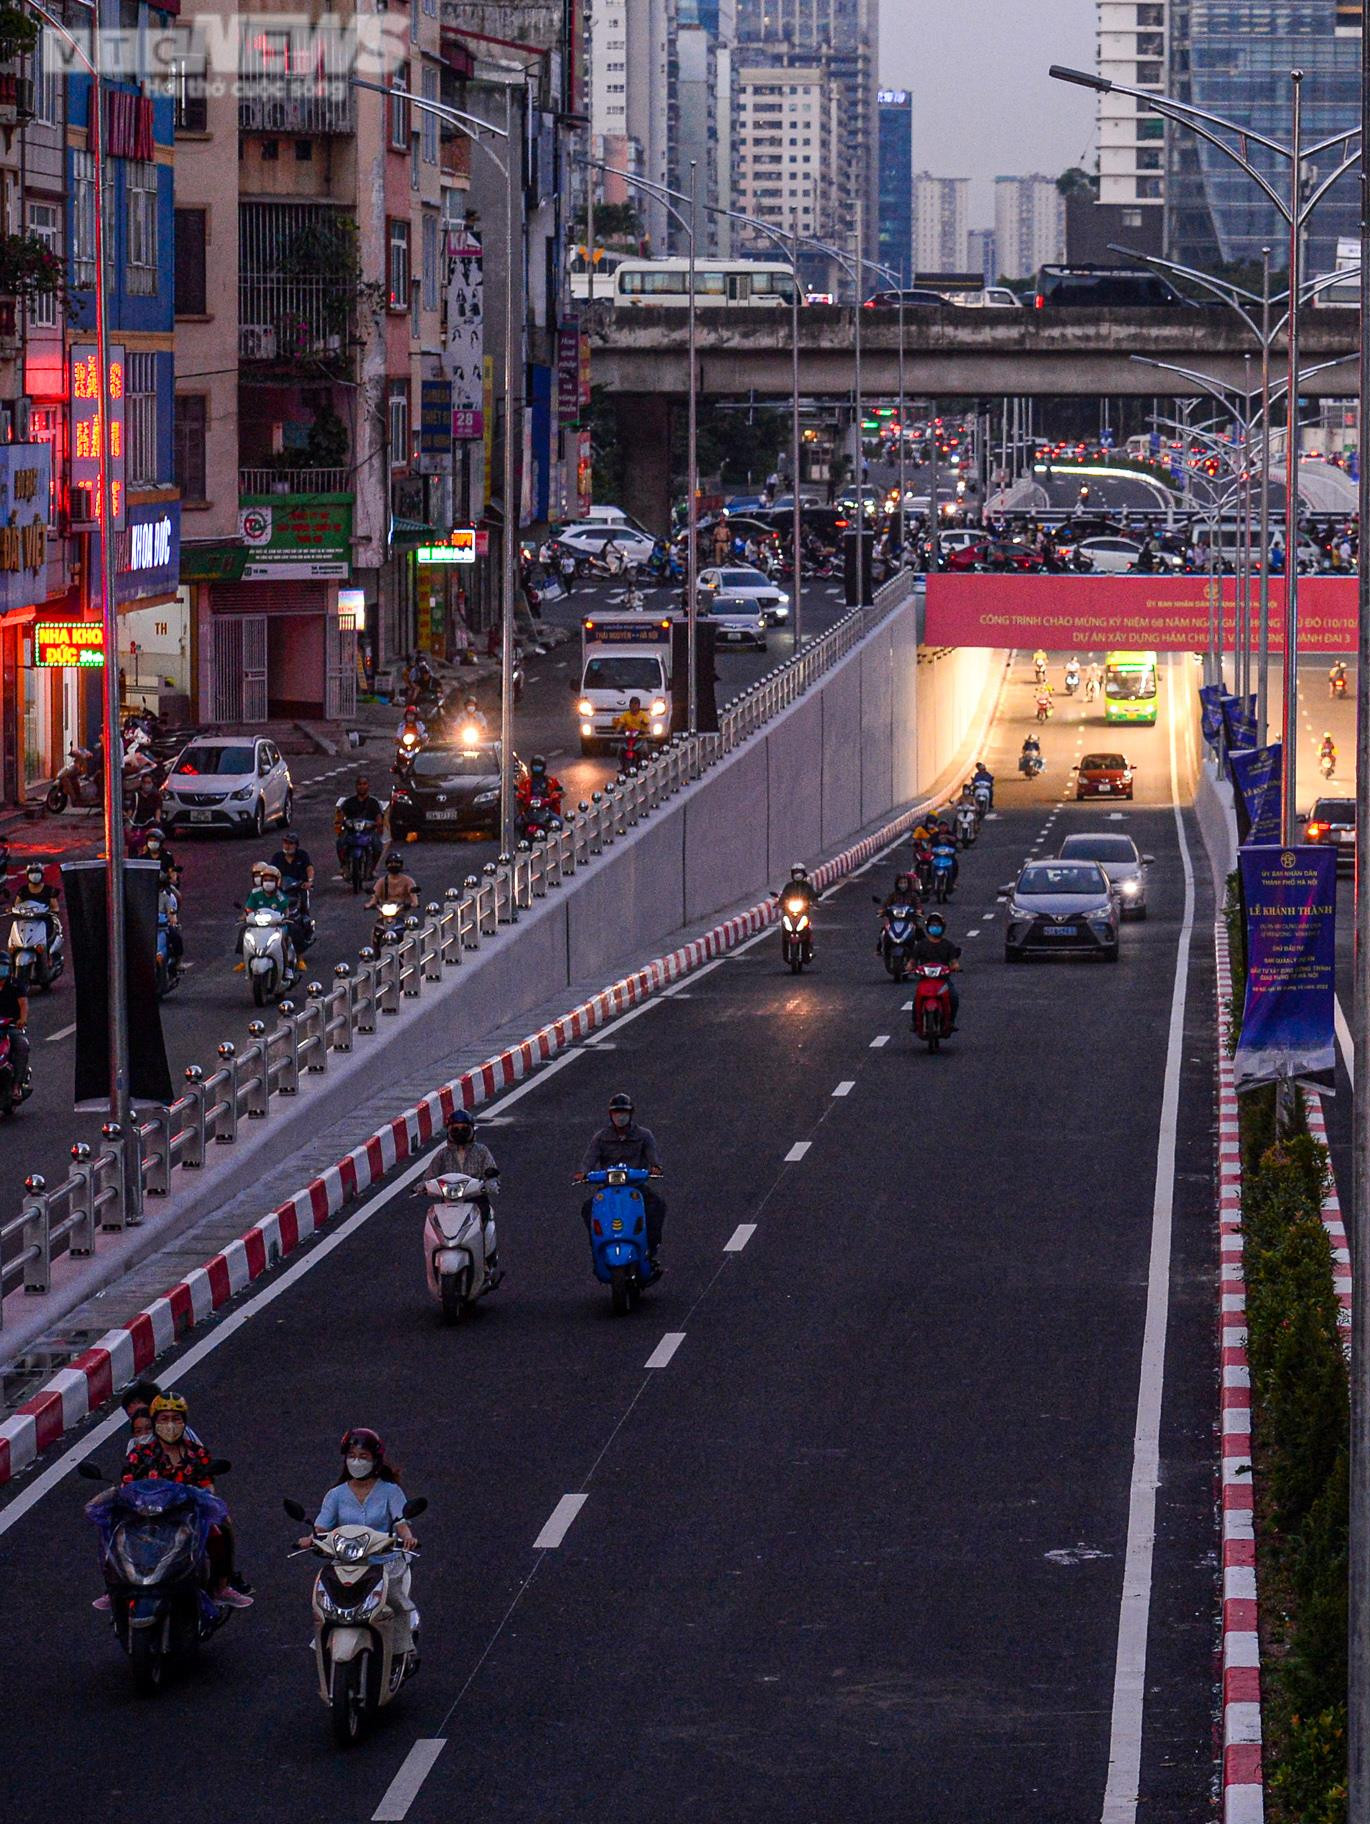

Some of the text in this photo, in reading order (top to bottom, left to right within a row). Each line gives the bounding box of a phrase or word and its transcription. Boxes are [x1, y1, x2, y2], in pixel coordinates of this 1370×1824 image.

[457, 413, 473, 426] 28
[131, 523, 153, 571] KHOA
[980, 614, 1009, 625] CÔNG
[1011, 614, 1041, 626] TRÌNH
[1043, 614, 1073, 626] CHÀO
[1124, 616, 1149, 629] NIỆM
[1151, 617, 1164, 627] 68
[1165, 616, 1190, 628] NĂM
[40, 628, 103, 644] NHA KHO
[1107, 631, 1127, 643] XÂY
[1129, 632, 1159, 643] DỰNG
[46, 644, 77, 663] ĐỨC
[1249, 903, 1332, 916] LỄ KHÁNH THÀNH
